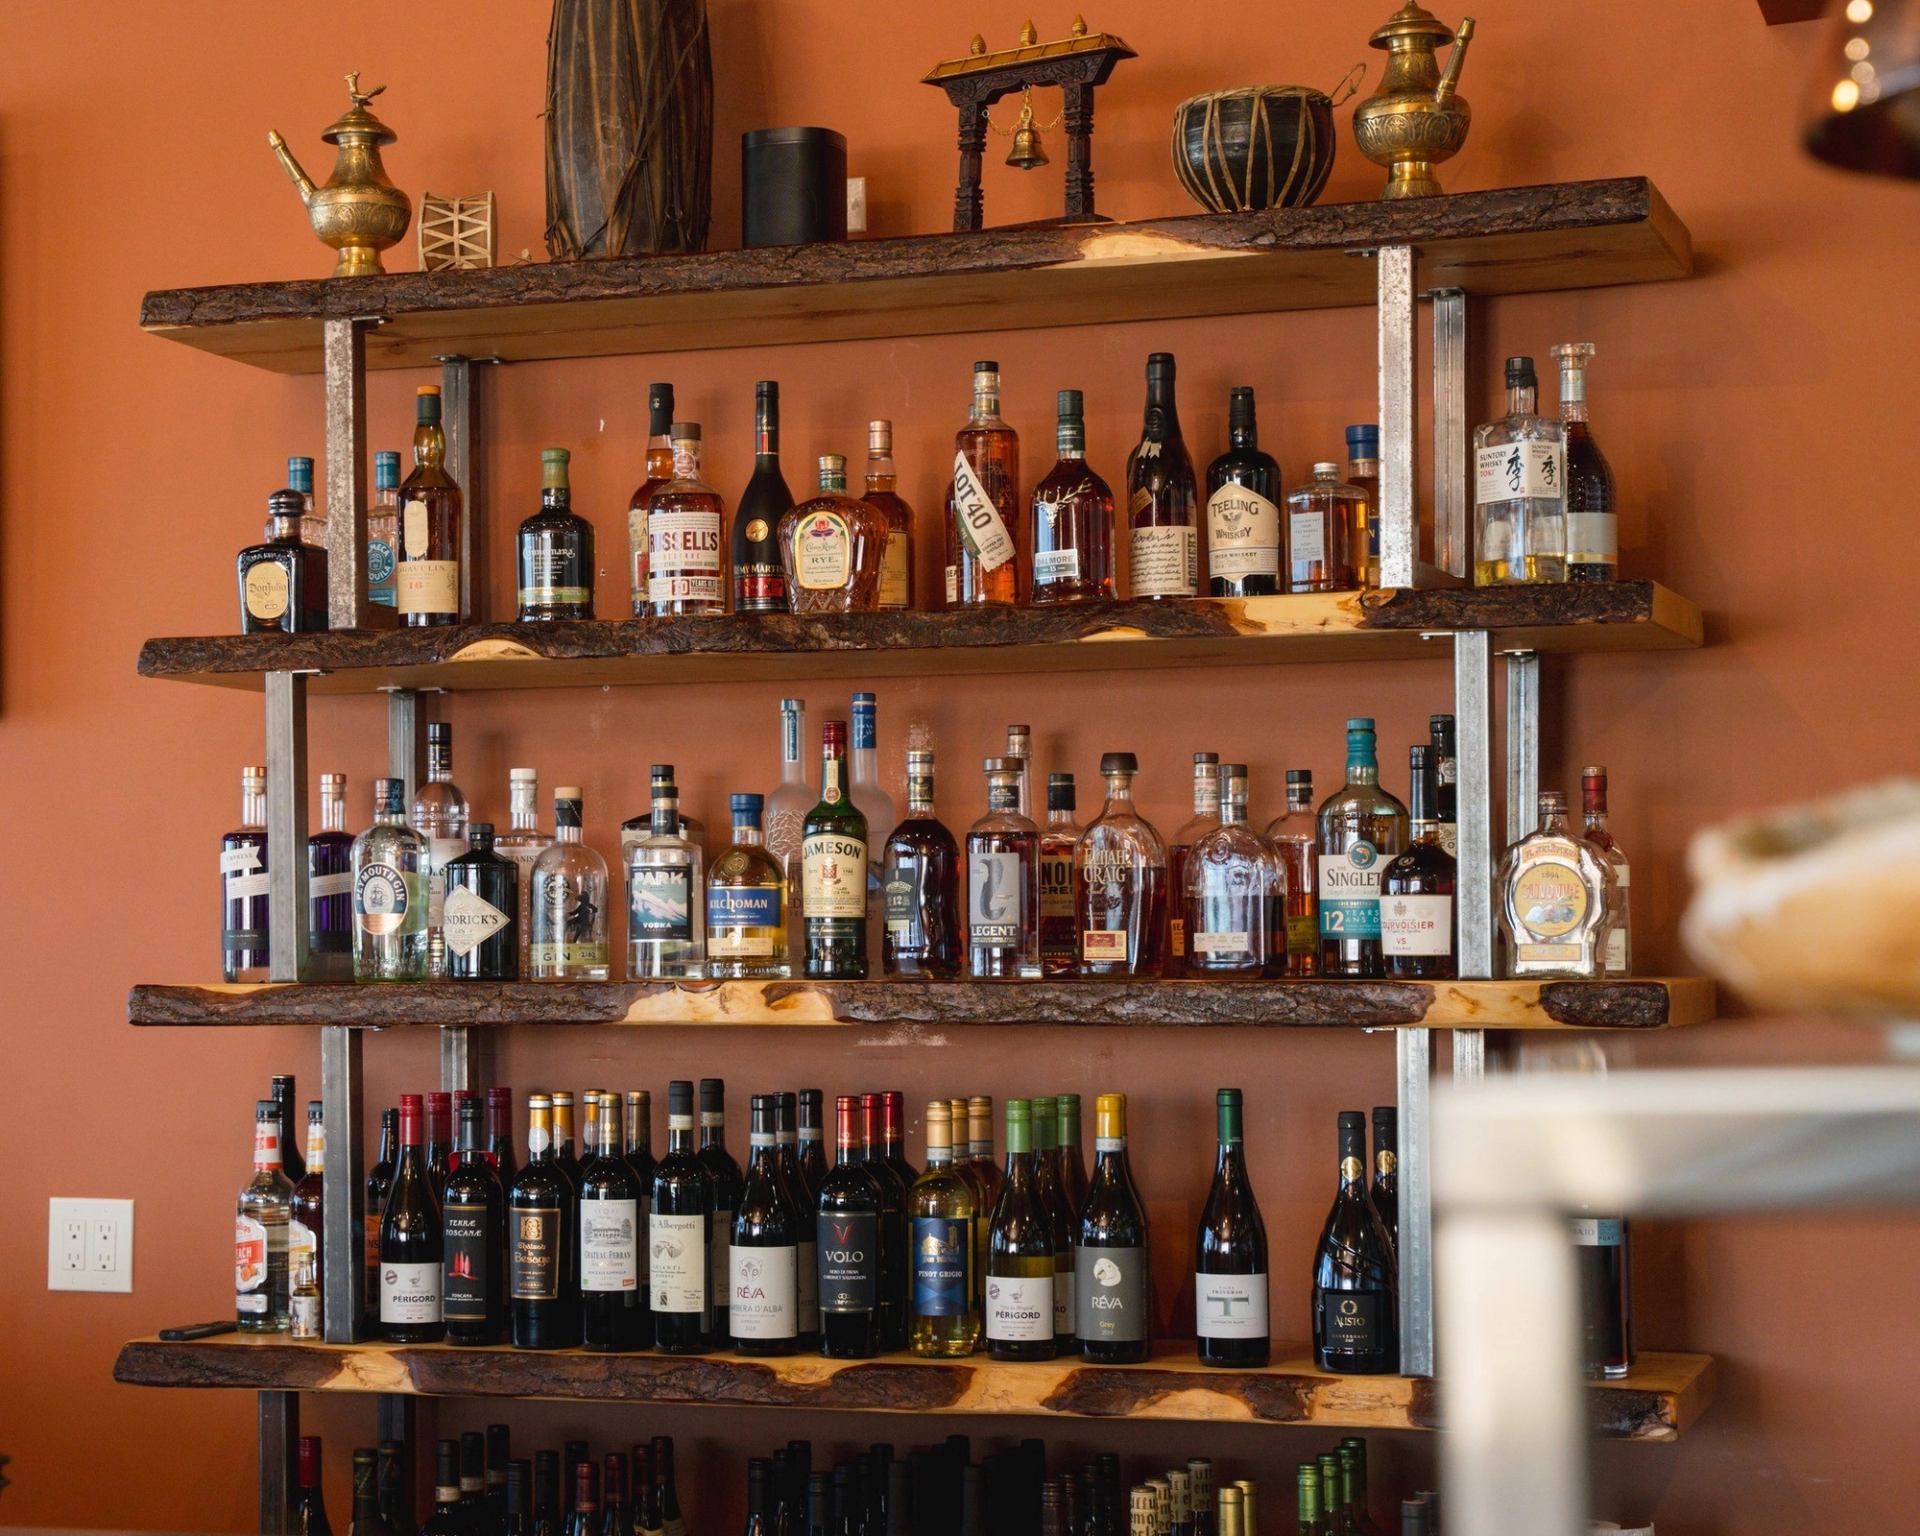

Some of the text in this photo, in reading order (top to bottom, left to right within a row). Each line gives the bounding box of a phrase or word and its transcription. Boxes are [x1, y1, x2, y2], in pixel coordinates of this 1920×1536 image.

[1480, 450, 1507, 462] SUNTORY
[1480, 459, 1503, 470] WHISKY
[1480, 469, 1495, 478] TOKI
[954, 462, 992, 529] LOT 40
[1211, 500, 1259, 517] TEELING
[1215, 526, 1252, 540] WHISKEY
[650, 531, 718, 553] RUSSELL'S
[368, 543, 390, 557] MECA
[368, 566, 391, 581] QUILA
[804, 841, 862, 859] JAMESON
[1084, 848, 1126, 867] ELIJAH
[633, 871, 684, 886] PARK
[1041, 862, 1073, 882] NO
[1084, 866, 1126, 884] CRAIG
[1327, 869, 1382, 887] SINGLET
[356, 865, 406, 901] PLYMOUTH GIN
[447, 914, 498, 925] NDRICK'S
[1324, 909, 1380, 931] 12 YEARS
[1383, 920, 1434, 930] OURVOISIER
[971, 925, 1016, 937] LEGENT
[543, 952, 571, 961] GIN
[826, 1250, 864, 1263] VOLO
[918, 1270, 963, 1278] PINOT GRIGIO
[1091, 1295, 1123, 1309] RÉVA
